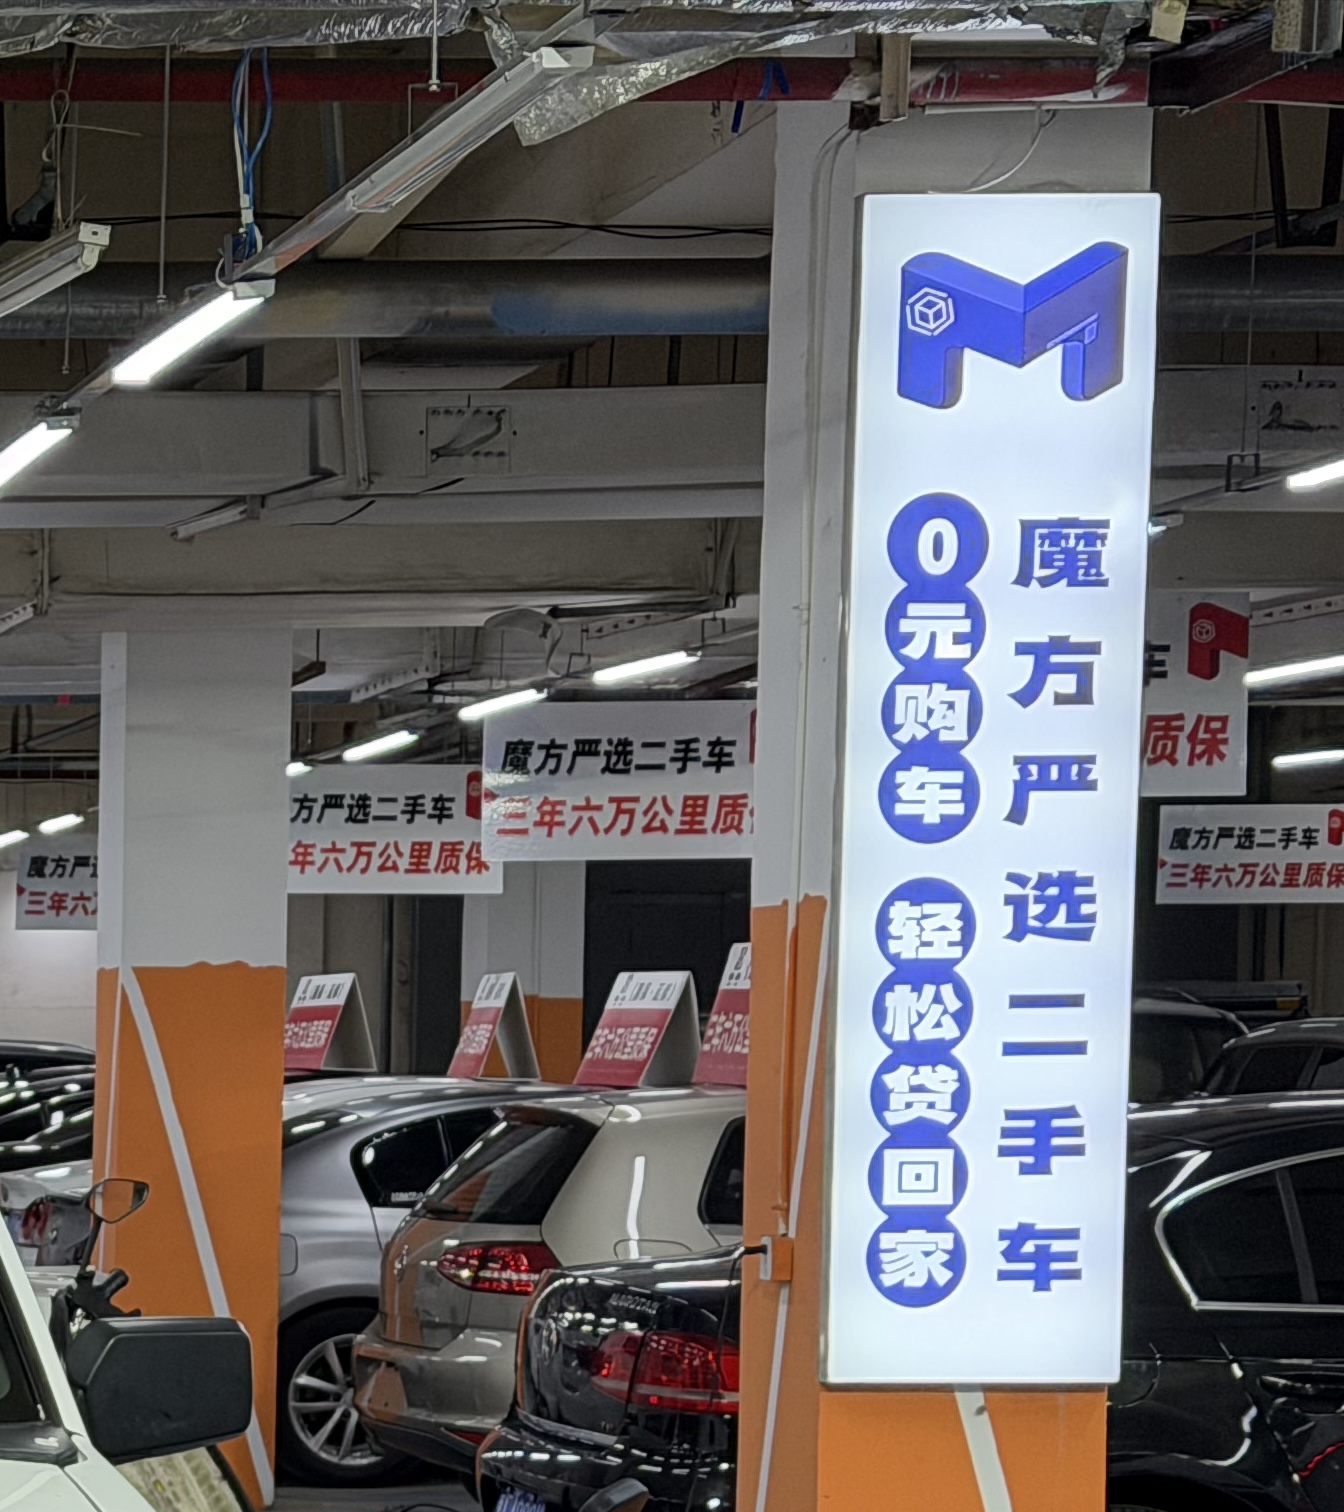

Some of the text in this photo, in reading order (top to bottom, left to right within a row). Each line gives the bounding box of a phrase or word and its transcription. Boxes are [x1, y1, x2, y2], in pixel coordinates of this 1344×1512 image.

[501, 736, 737, 775] 魔方严选二手车
[289, 793, 456, 824] 方严选二手车
[496, 793, 754, 838] 三年六万公里质
[1169, 826, 1320, 850] 魔方严选二手车
[996, 516, 1112, 1292] 魔方严选二手车
[875, 899, 966, 1290] 轻松贷回家
